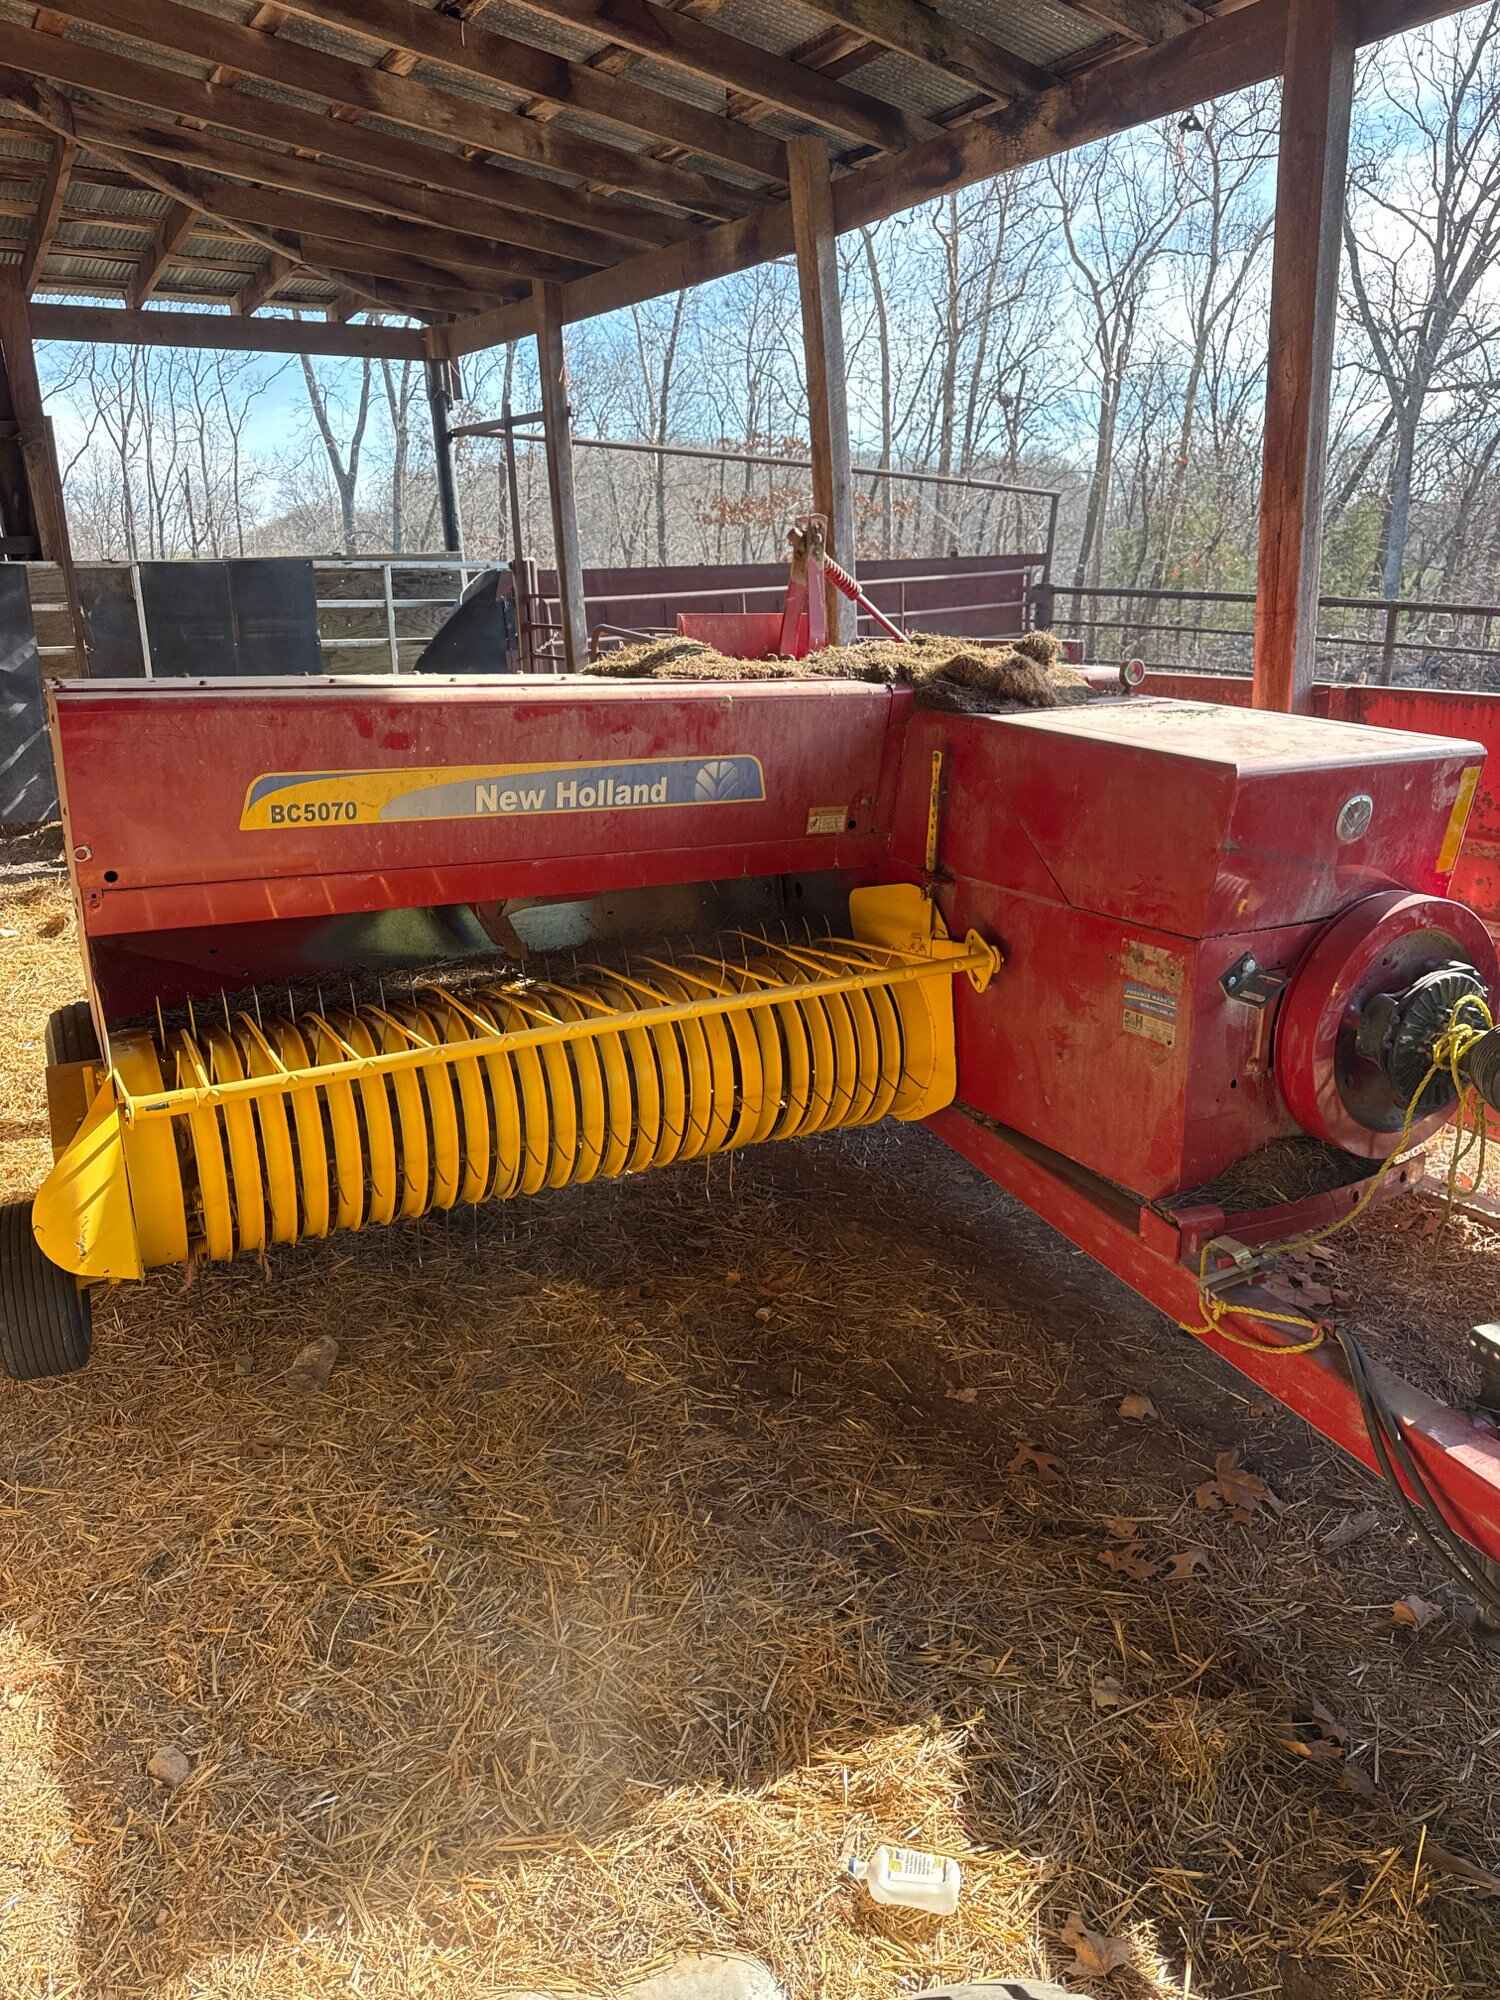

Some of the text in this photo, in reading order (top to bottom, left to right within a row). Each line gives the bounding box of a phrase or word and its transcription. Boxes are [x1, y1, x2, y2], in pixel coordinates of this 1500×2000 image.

[475, 776, 667, 812] New Holland
[270, 801, 357, 824] BC5070
